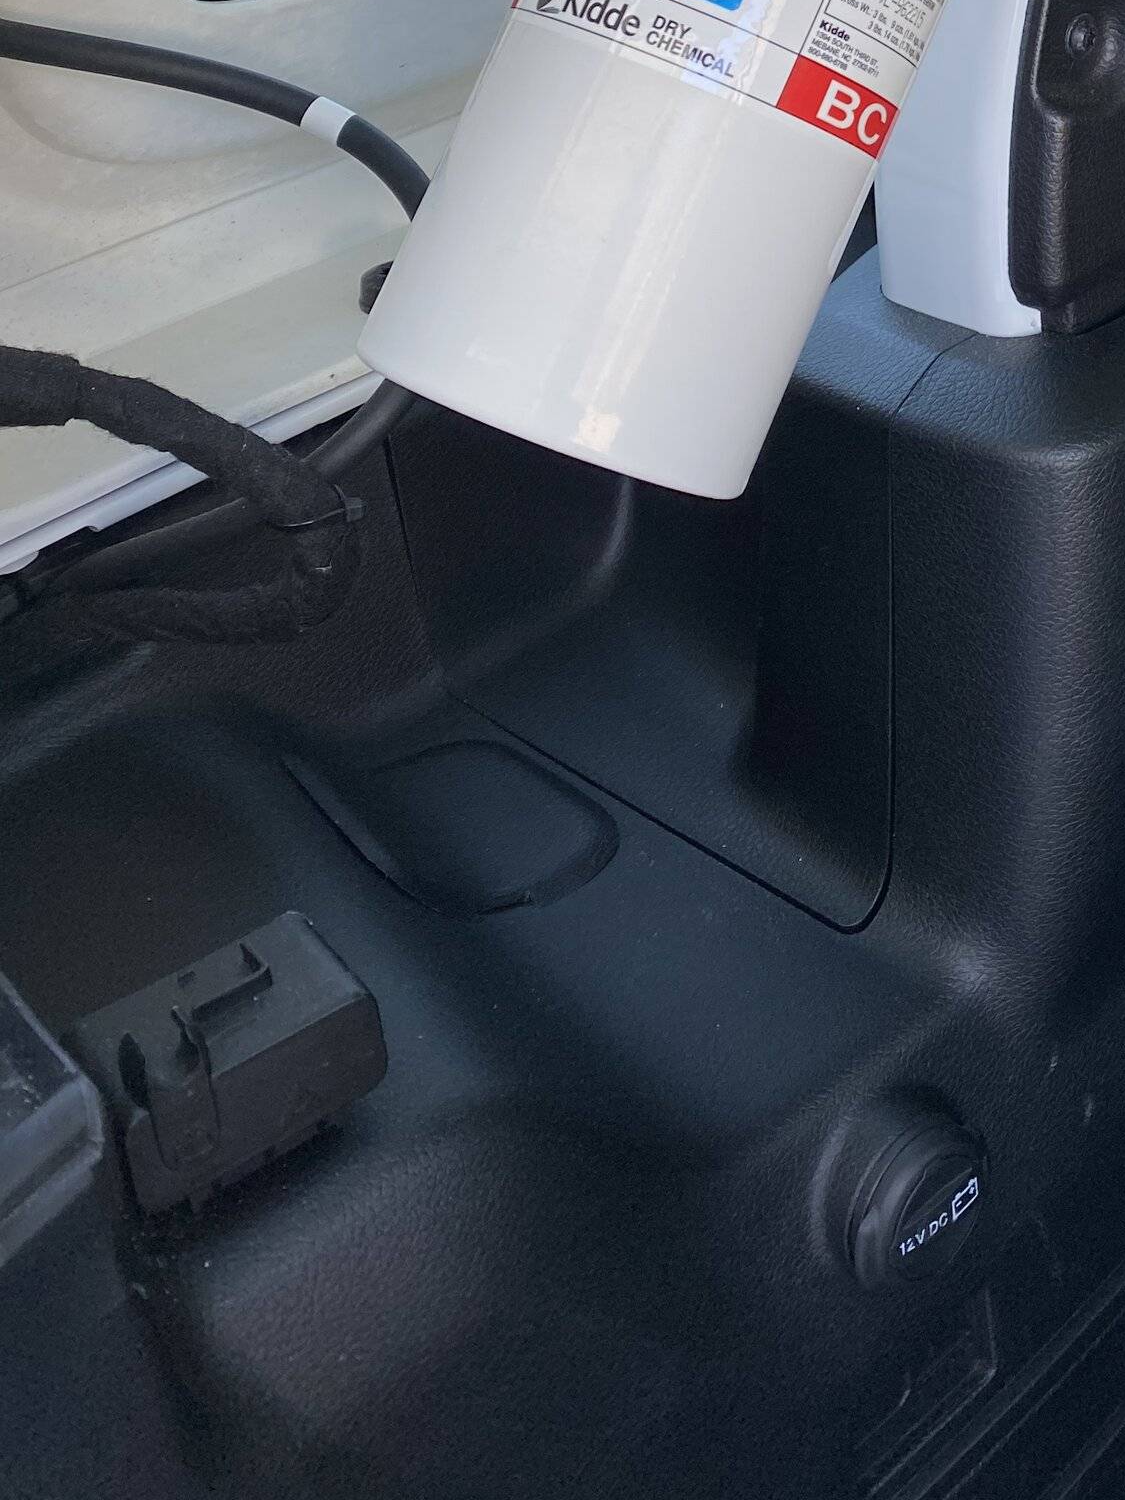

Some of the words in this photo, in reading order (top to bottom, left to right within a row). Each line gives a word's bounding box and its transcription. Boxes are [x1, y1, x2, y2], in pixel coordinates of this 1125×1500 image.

[652, 15, 691, 39] DRY
[819, 19, 850, 41] Kidde
[646, 30, 735, 78] CHEMICAL
[831, 37, 854, 54] SOUTH
[840, 52, 852, 62] NC
[816, 78, 888, 146] BC
[928, 1212, 949, 1236] DC
